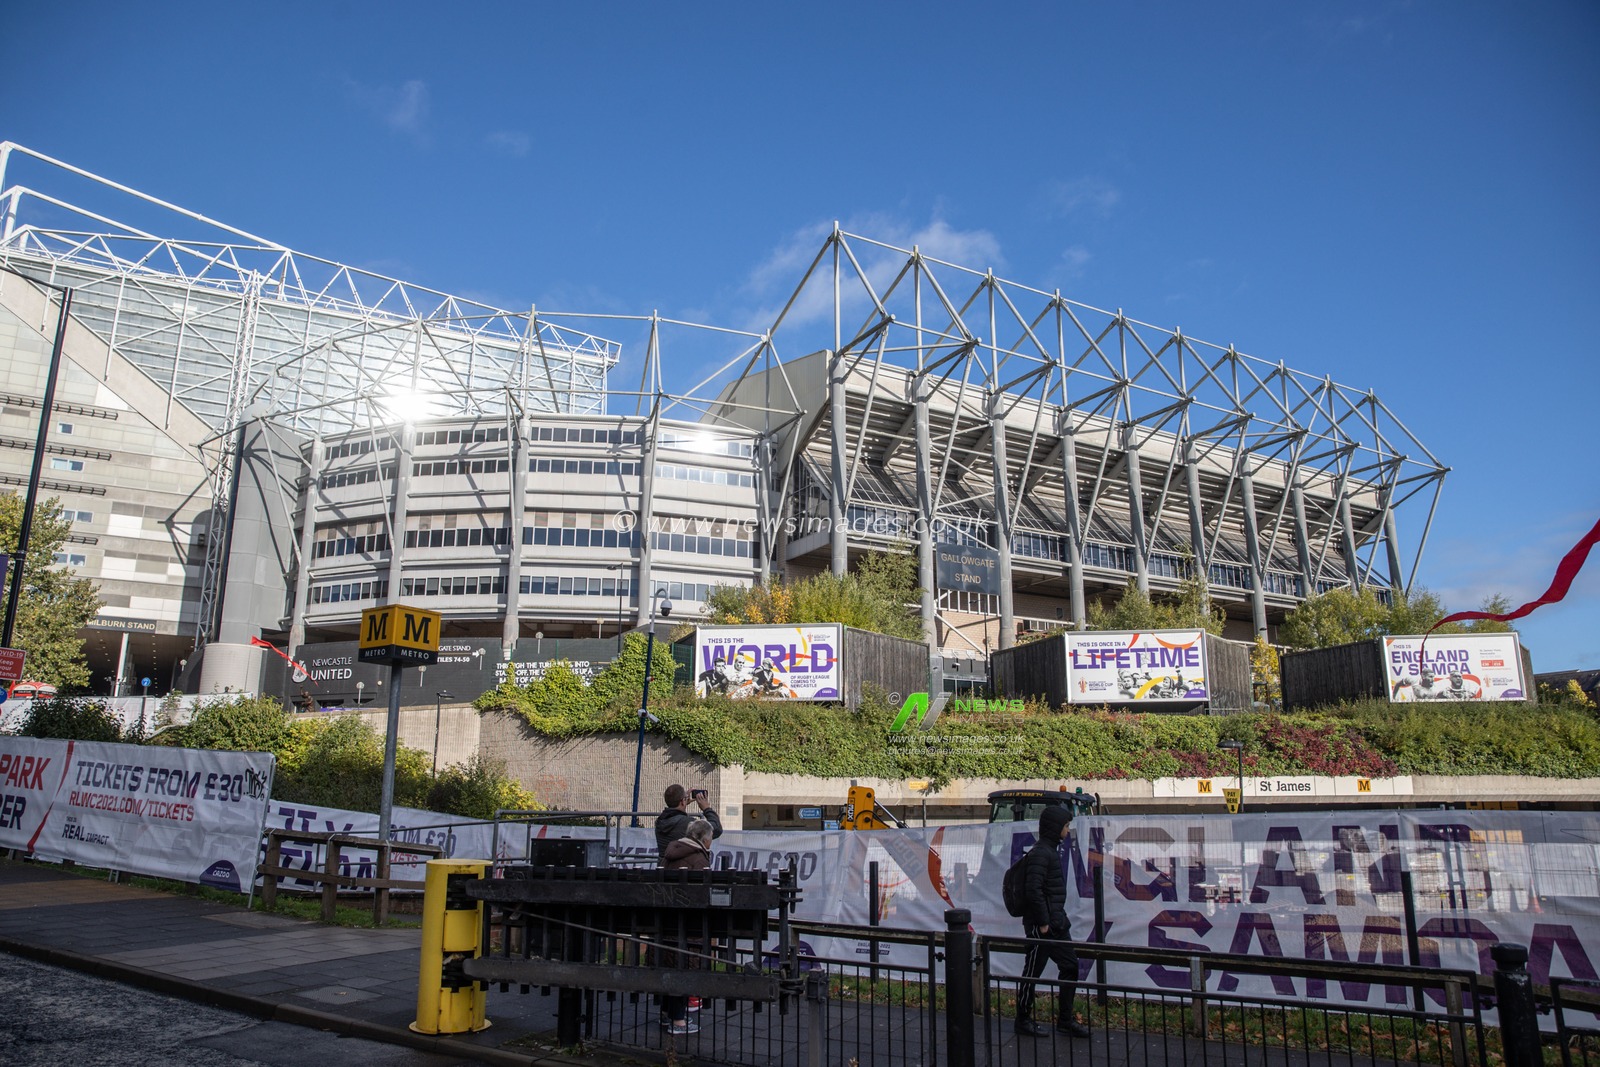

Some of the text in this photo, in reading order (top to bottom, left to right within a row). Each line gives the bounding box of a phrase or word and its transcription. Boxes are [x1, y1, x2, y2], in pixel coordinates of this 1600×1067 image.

[940, 552, 995, 569] GALLOWGATE
[955, 572, 982, 585] STAND
[127, 621, 156, 630] STAND
[367, 612, 389, 642] M
[402, 613, 432, 645] M
[365, 648, 386, 658] METRO
[401, 649, 430, 660] METRO
[702, 643, 834, 673] WORLD
[1073, 647, 1200, 669] LIFETIME
[1391, 650, 1470, 664] ENGLAND
[312, 657, 352, 667] NEWCASTLE
[574, 660, 590, 668] INTO
[310, 668, 353, 681] UNITED
[1392, 666, 1403, 676] V
[0, 754, 52, 791] PARK
[75, 760, 145, 792] TICKETS
[145, 768, 201, 799] FROM
[203, 773, 244, 803] £30
[1260, 780, 1311, 792] St James
[69, 791, 195, 822] RLWC2021.COM/TICKETS
[62, 823, 110, 845] REAL IMPACT
[1145, 909, 1600, 1019] SAMOA
